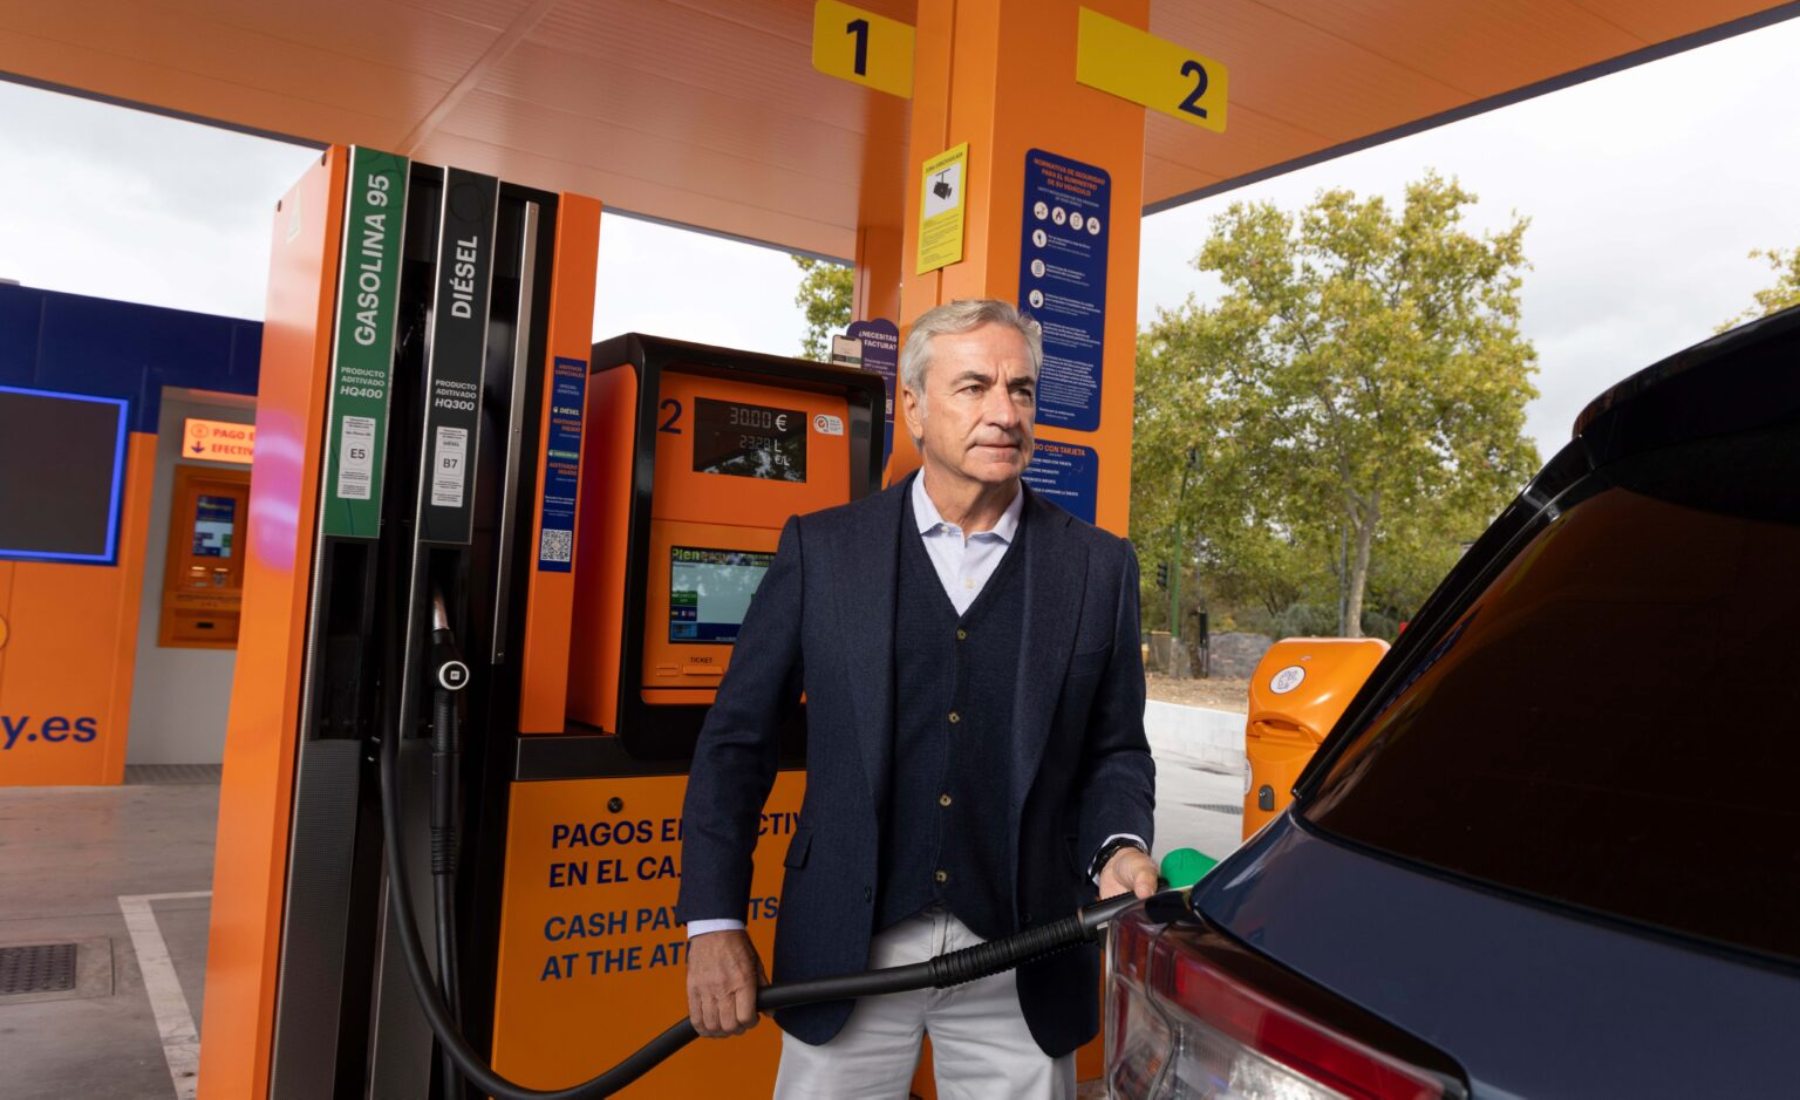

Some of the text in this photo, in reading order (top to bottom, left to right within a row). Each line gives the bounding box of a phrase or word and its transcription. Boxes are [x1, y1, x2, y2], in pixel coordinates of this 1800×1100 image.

[846, 18, 869, 77] 1
[1177, 60, 1209, 119] 2
[354, 174, 389, 346] GASOLINA 95
[449, 235, 478, 319] DIÉSEL
[341, 366, 385, 378] PRODUCTO
[341, 375, 385, 387] ADITIVADO
[435, 379, 477, 391] PRODUCTO
[340, 386, 383, 399] HQ400
[436, 388, 477, 399] ADITIVADO
[435, 398, 475, 411] HQ300
[658, 398, 682, 434] 2
[213, 428, 245, 440] PAGO
[212, 443, 254, 457] EFECTIV
[350, 448, 366, 459] E5
[443, 458, 458, 469] B7
[552, 820, 653, 848] PAGOS
[549, 861, 588, 887] EN
[597, 859, 629, 883] EL
[544, 910, 627, 942] CASH
[541, 954, 579, 981] AT
[587, 947, 642, 975] THE
